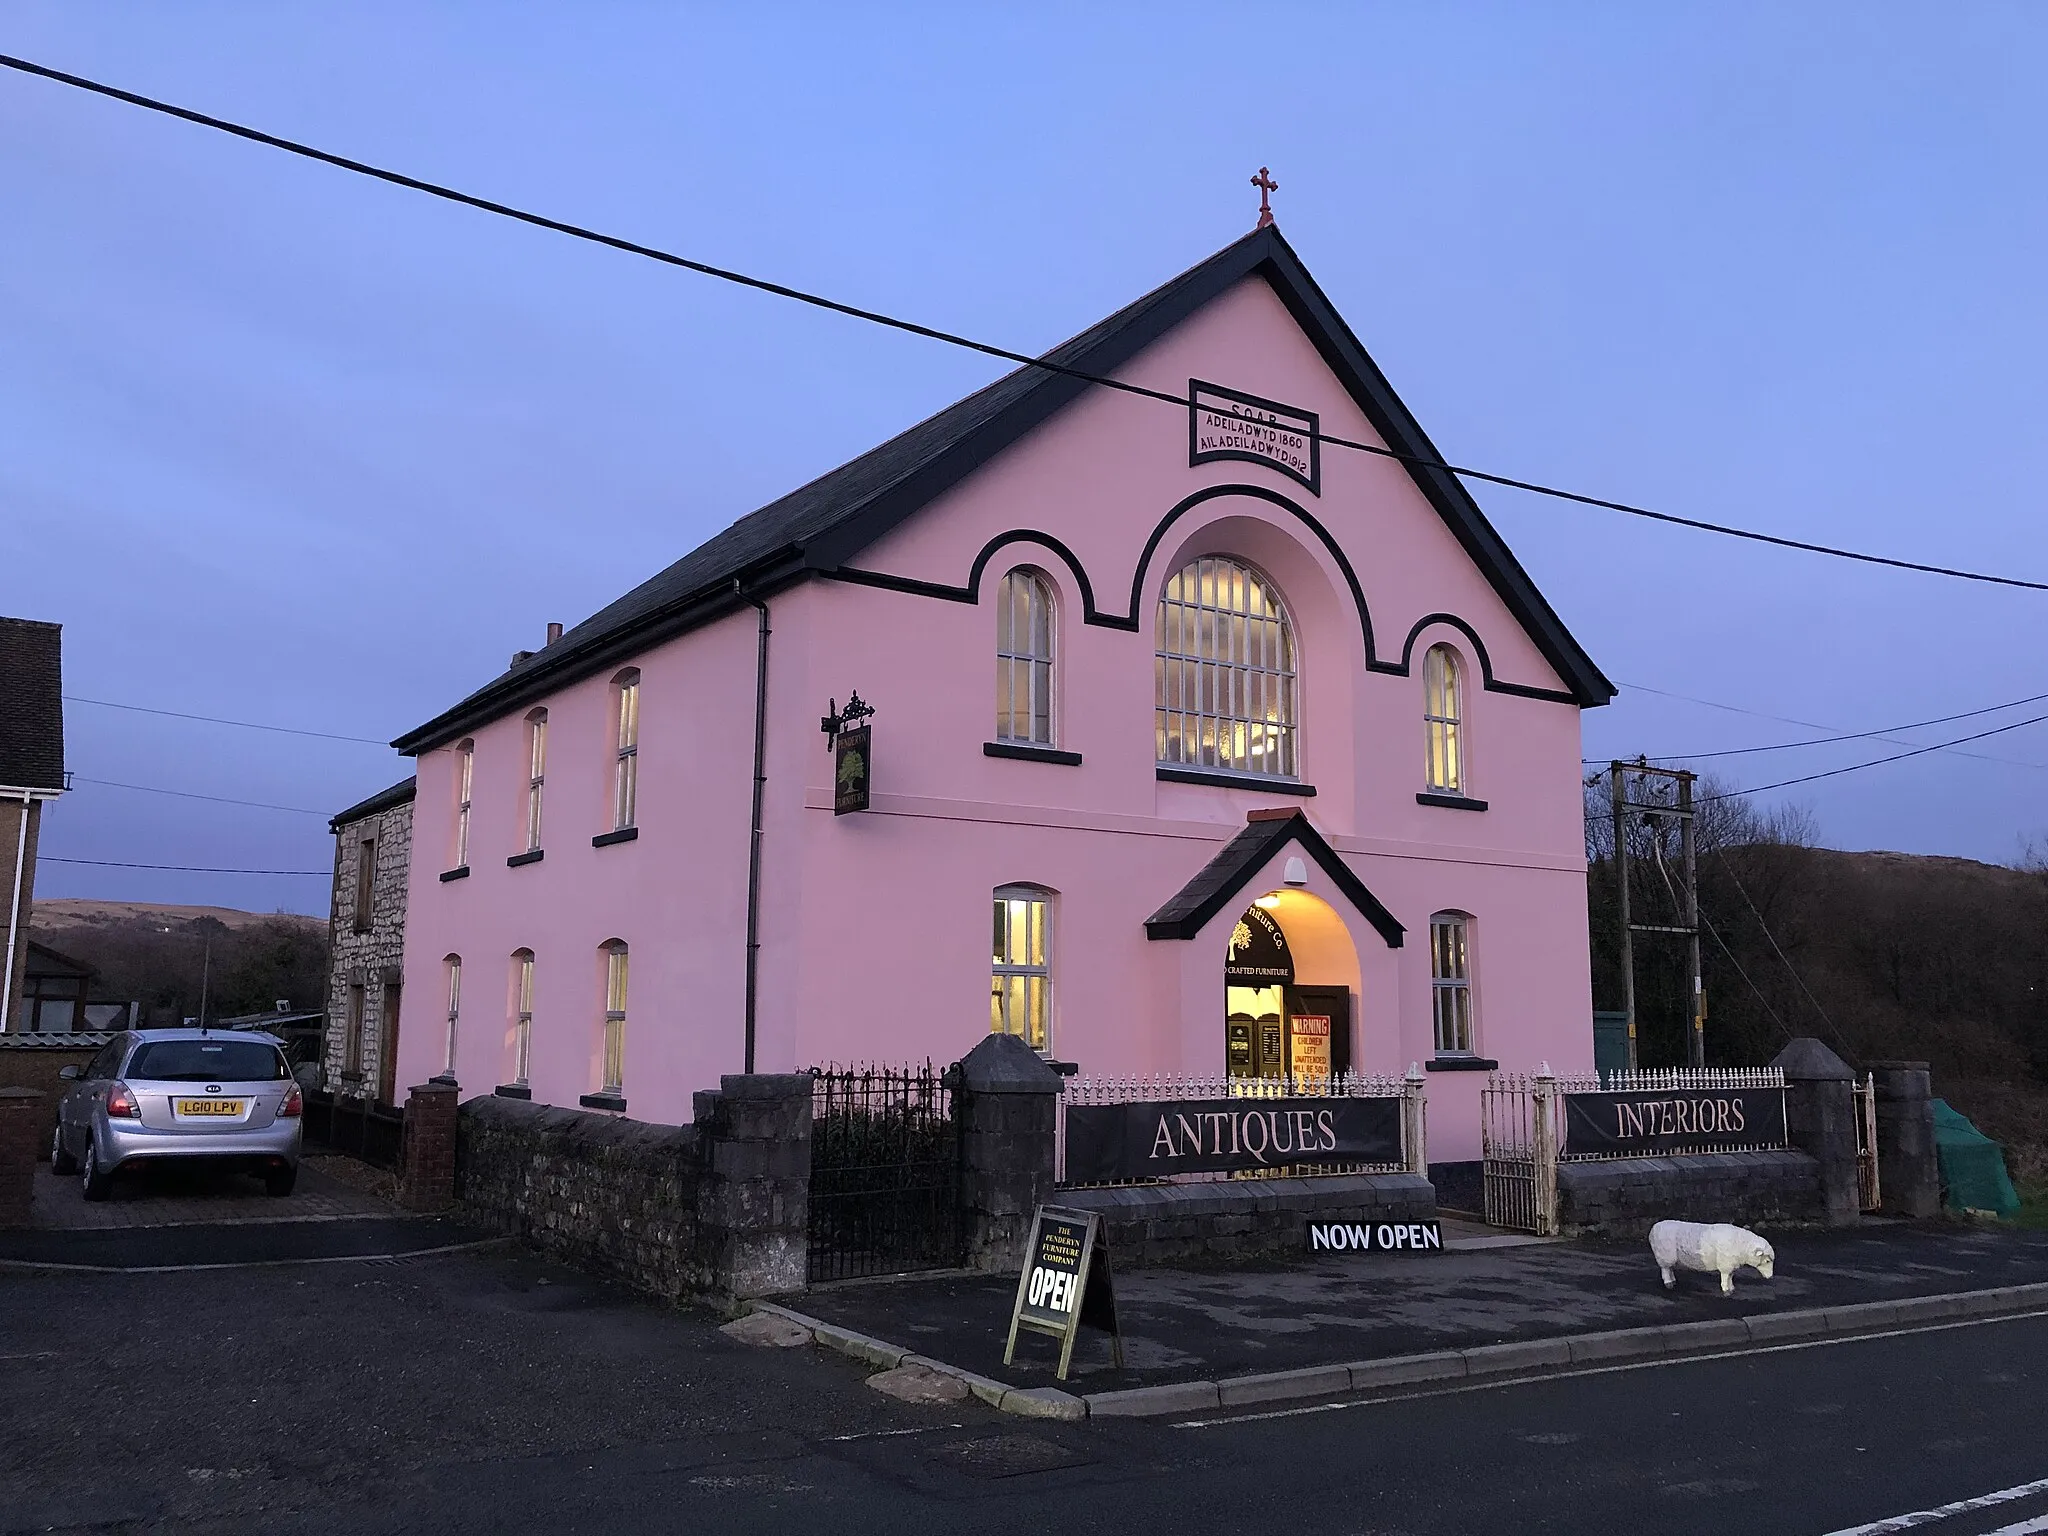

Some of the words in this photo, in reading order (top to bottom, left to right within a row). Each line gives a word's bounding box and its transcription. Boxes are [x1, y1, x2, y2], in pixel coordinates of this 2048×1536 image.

[1206, 414, 1277, 442] ADEILADWYD
[1279, 432, 1303, 449] 1860
[1289, 453, 1308, 473] 1912
[1245, 906, 1275, 933] niture
[1227, 966, 1255, 975] CRAFTED
[1255, 967, 1289, 976] FURNITURE
[1292, 1018, 1328, 1035] WARNING
[1297, 1036, 1323, 1046] CHILDREN
[1303, 1046, 1317, 1055] LEFT
[1294, 1056, 1327, 1065] UNATTENDED
[1292, 1064, 1305, 1073] WILL
[1306, 1064, 1314, 1073] BE
[1315, 1065, 1328, 1074] SOLD
[184, 1102, 211, 1113] LG10
[213, 1101, 237, 1113] LPV
[1615, 1098, 1745, 1139] INTERIORS
[1148, 1109, 1337, 1164] ANTIQUES
[1057, 1226, 1072, 1236] THE
[1311, 1224, 1371, 1250] NOW
[1377, 1224, 1440, 1249] OPEN
[1045, 1234, 1081, 1248] PENDERYN
[1042, 1243, 1080, 1257] FURNITURE
[1042, 1253, 1076, 1266] COMPANY
[1028, 1266, 1079, 1313] OPEN
